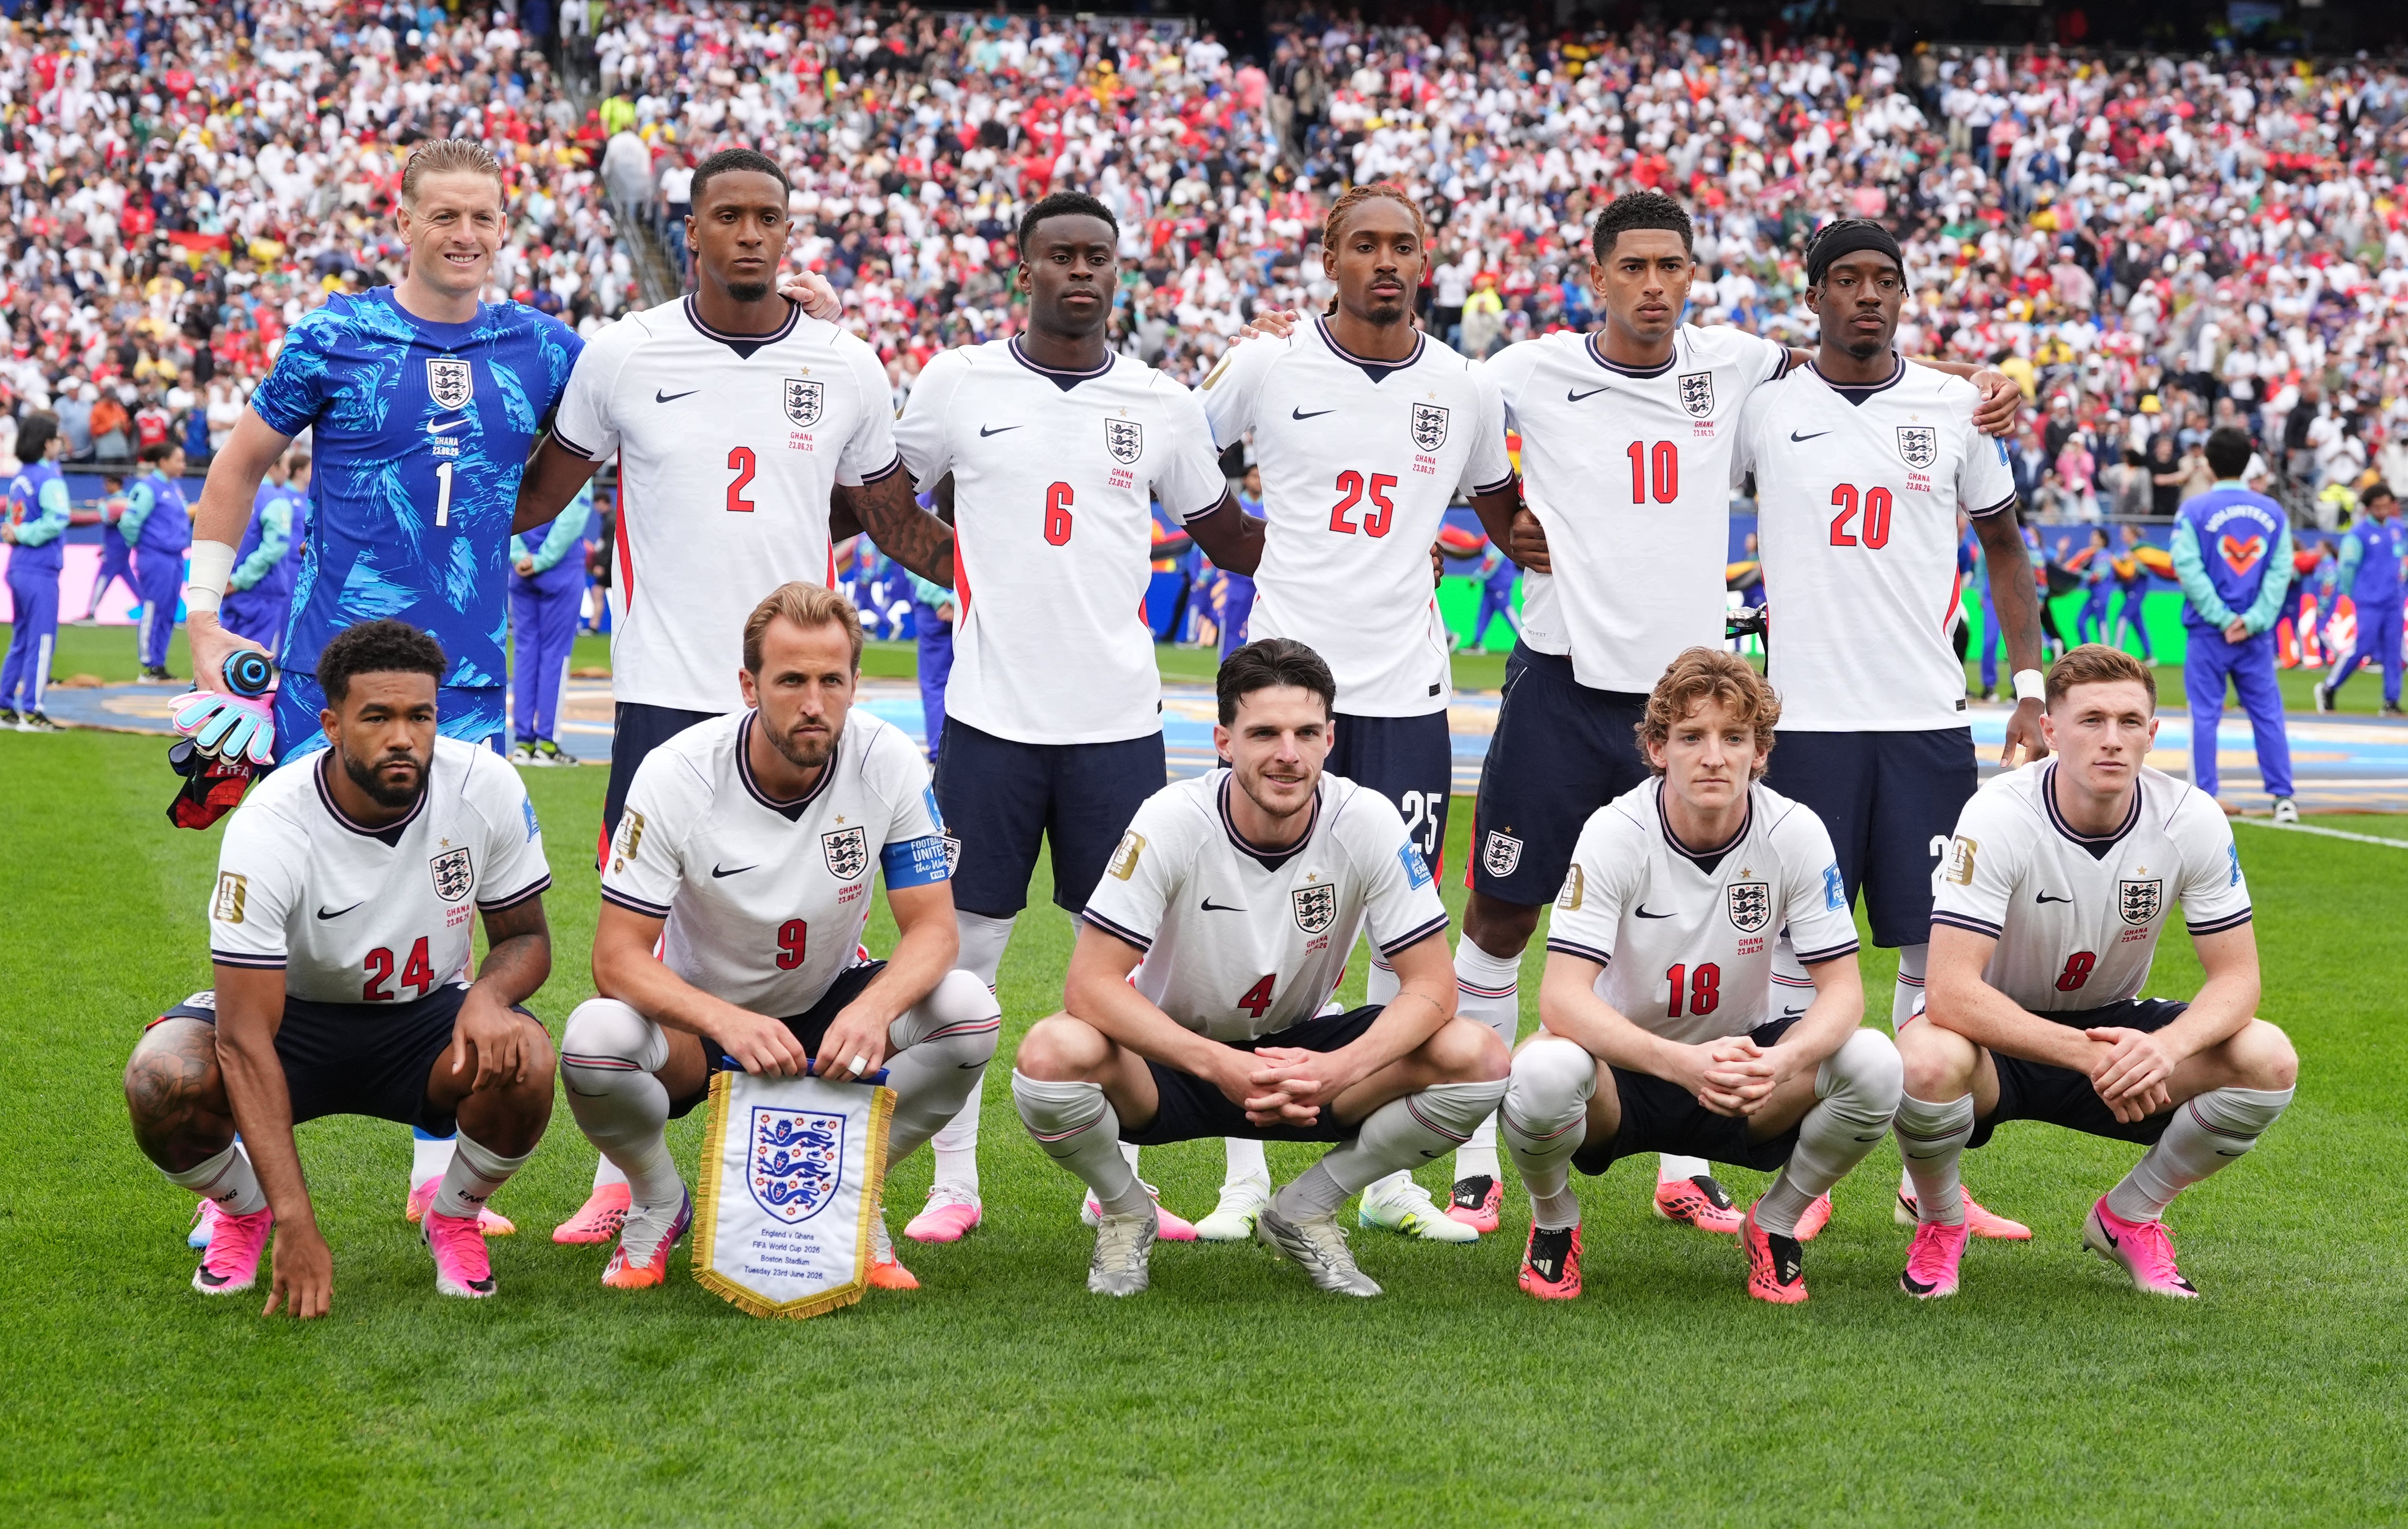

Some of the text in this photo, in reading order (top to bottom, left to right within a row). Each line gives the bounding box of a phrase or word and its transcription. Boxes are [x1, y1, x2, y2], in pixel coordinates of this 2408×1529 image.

[434, 437, 459, 446] GHANA
[791, 432, 812, 442] GHANA
[432, 447, 460, 456] 23.06.26
[789, 441, 813, 451] 23.06.26
[1415, 454, 1436, 465] GHANA
[1112, 468, 1134, 480] GHANA
[1413, 464, 1435, 475] 23.06.26
[1627, 441, 1678, 504] 10
[726, 446, 756, 513] 2
[1108, 477, 1132, 489] 23.06.26
[1908, 473, 1930, 483] GHANA
[1906, 482, 1931, 493] 23.06.26
[435, 461, 453, 527] 1
[1329, 469, 1398, 538] 25
[1044, 481, 1074, 547] 6
[1830, 483, 1893, 550] 20
[2204, 504, 2277, 533] VOLUNTEER
[1402, 790, 1443, 855] 25
[912, 845, 945, 862] UNITES
[913, 863, 931, 873] the
[1413, 865, 1428, 877] PEAC
[932, 870, 944, 879] FIFA
[839, 883, 862, 895] GHANA
[446, 904, 470, 917] GHANA
[2124, 927, 2148, 936] GHANA
[776, 918, 807, 971] 9
[1306, 935, 1328, 948] GHANA
[1738, 937, 1764, 946] GHANA
[2121, 934, 2147, 943] 23.06.26
[1737, 945, 1764, 955] 23.06.26
[363, 935, 434, 1001] 24
[2055, 951, 2097, 992] 8
[1237, 973, 1277, 1018] 4
[1666, 962, 1720, 1018] 18
[761, 1229, 786, 1238] England
[794, 1232, 814, 1241] Ghana
[752, 1241, 766, 1249] FIFA
[769, 1242, 787, 1251] World
[789, 1245, 801, 1254] Cup
[760, 1255, 809, 1266] Boston Stadium
[744, 1265, 771, 1277] Tuesday
